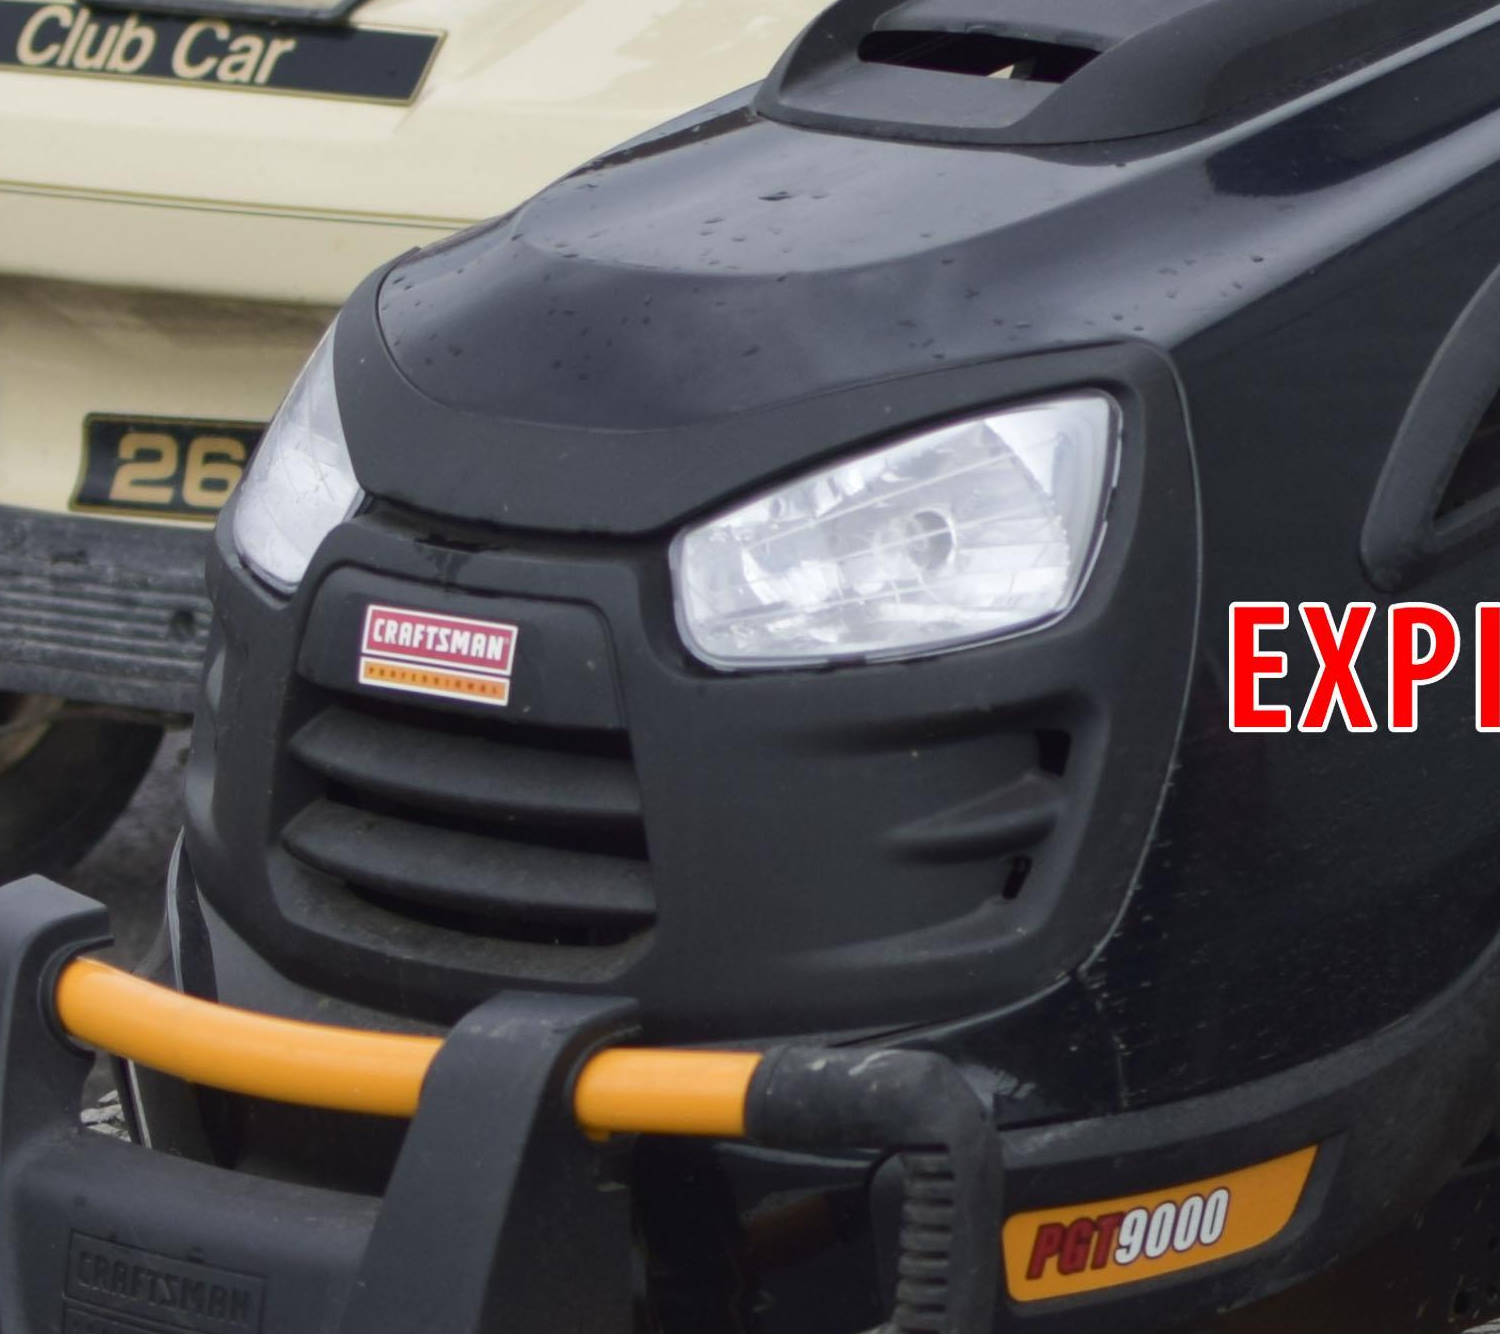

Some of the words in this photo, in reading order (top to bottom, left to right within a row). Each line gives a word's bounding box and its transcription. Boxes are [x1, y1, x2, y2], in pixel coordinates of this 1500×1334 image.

[15, 4, 157, 74] Club
[171, 19, 297, 85] Car
[372, 617, 505, 662] CRAFTSMAN
[1025, 1186, 1231, 1281] PGT9000
[76, 1249, 251, 1325] CRAFTSMAN
